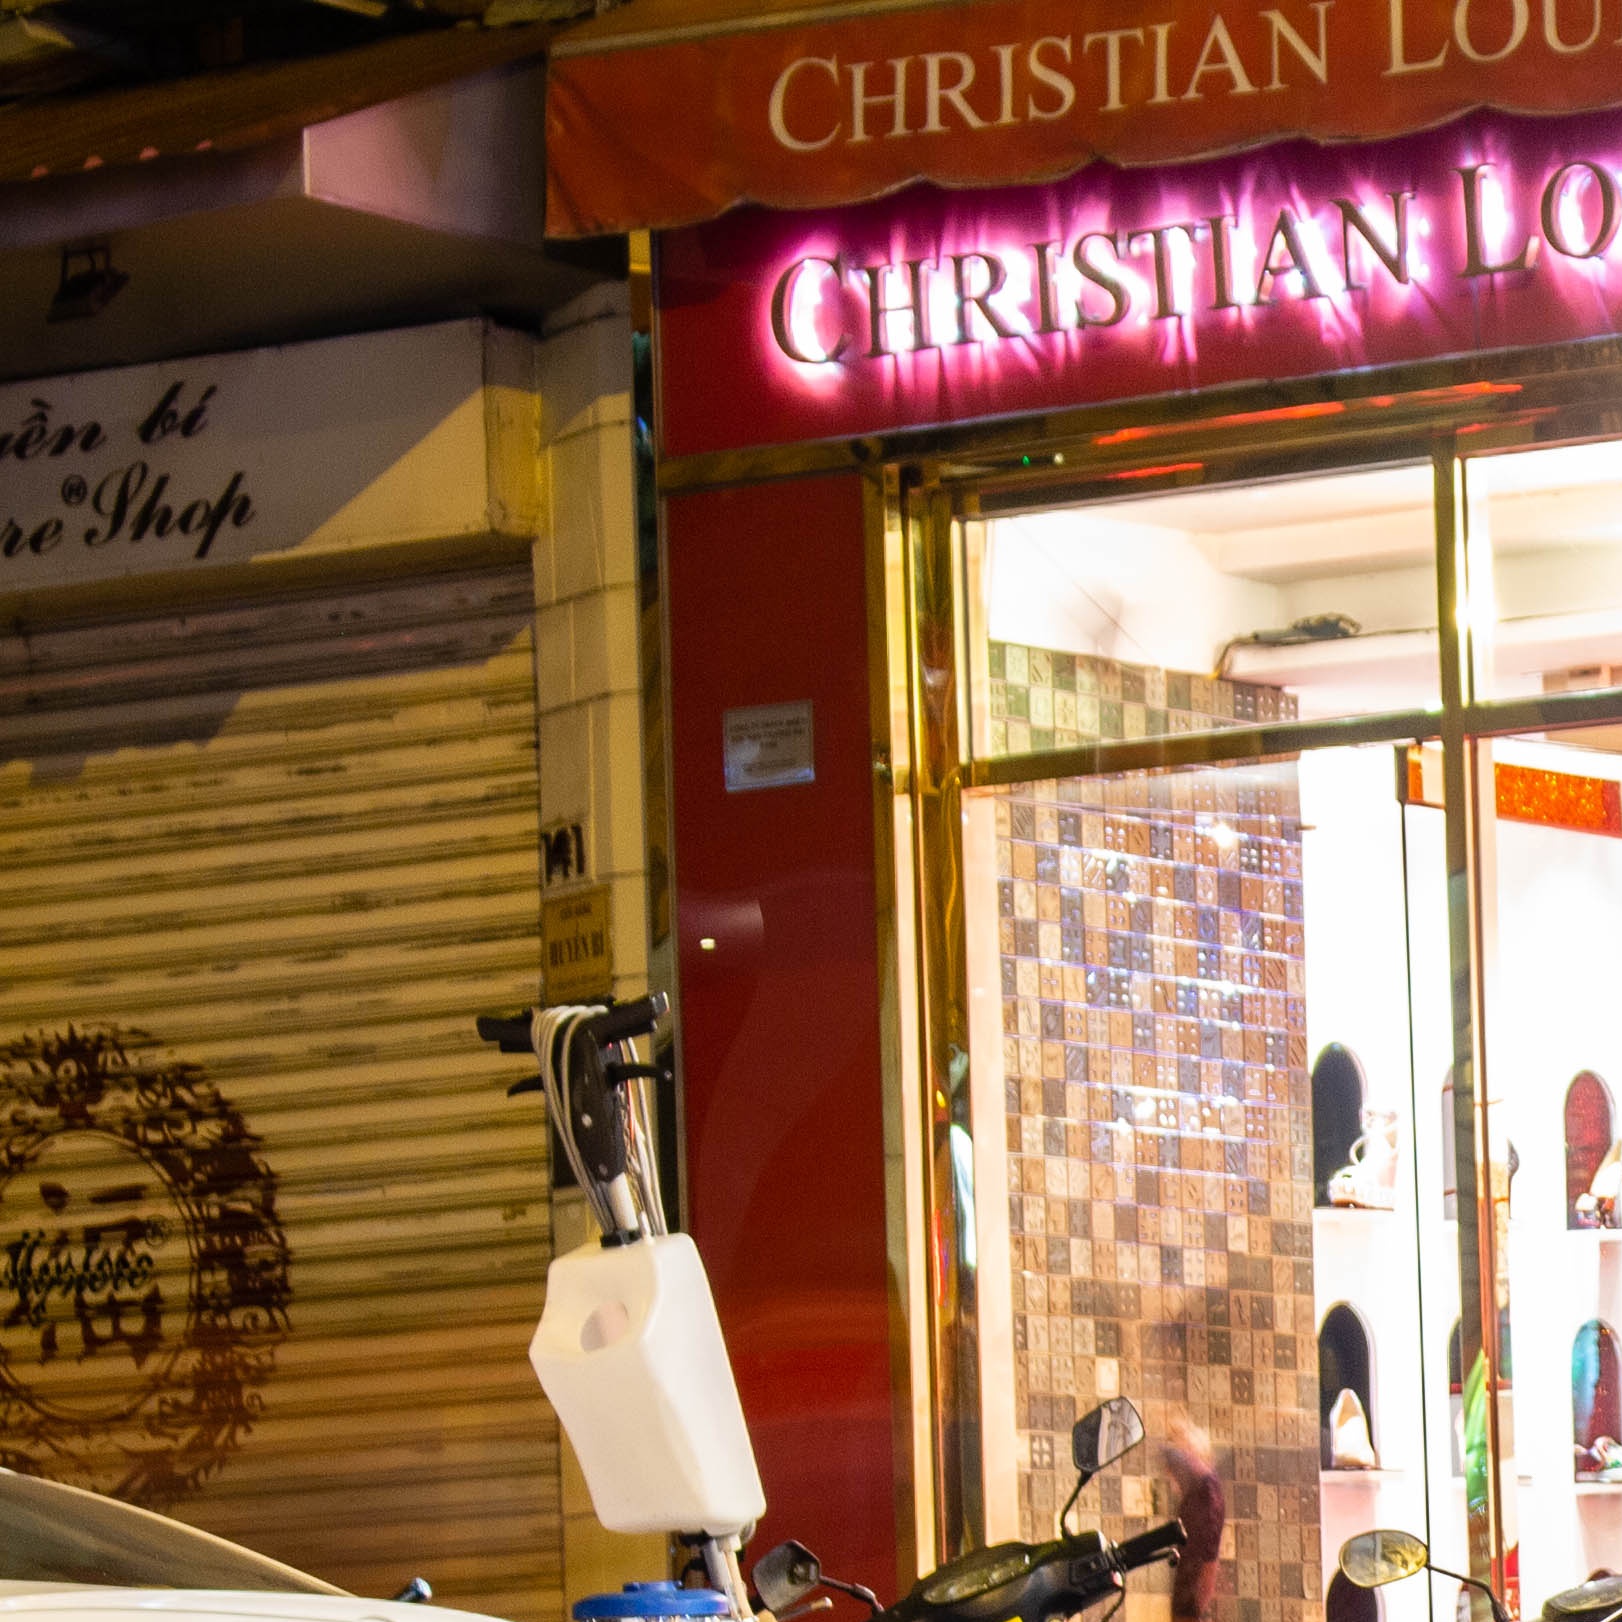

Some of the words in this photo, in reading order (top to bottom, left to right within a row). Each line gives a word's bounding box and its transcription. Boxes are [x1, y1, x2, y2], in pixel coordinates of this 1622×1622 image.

[768, 2, 1336, 152] CHRISTIAN
[770, 193, 1414, 365] CHRISTIAN
[84, 461, 255, 559] Shop
